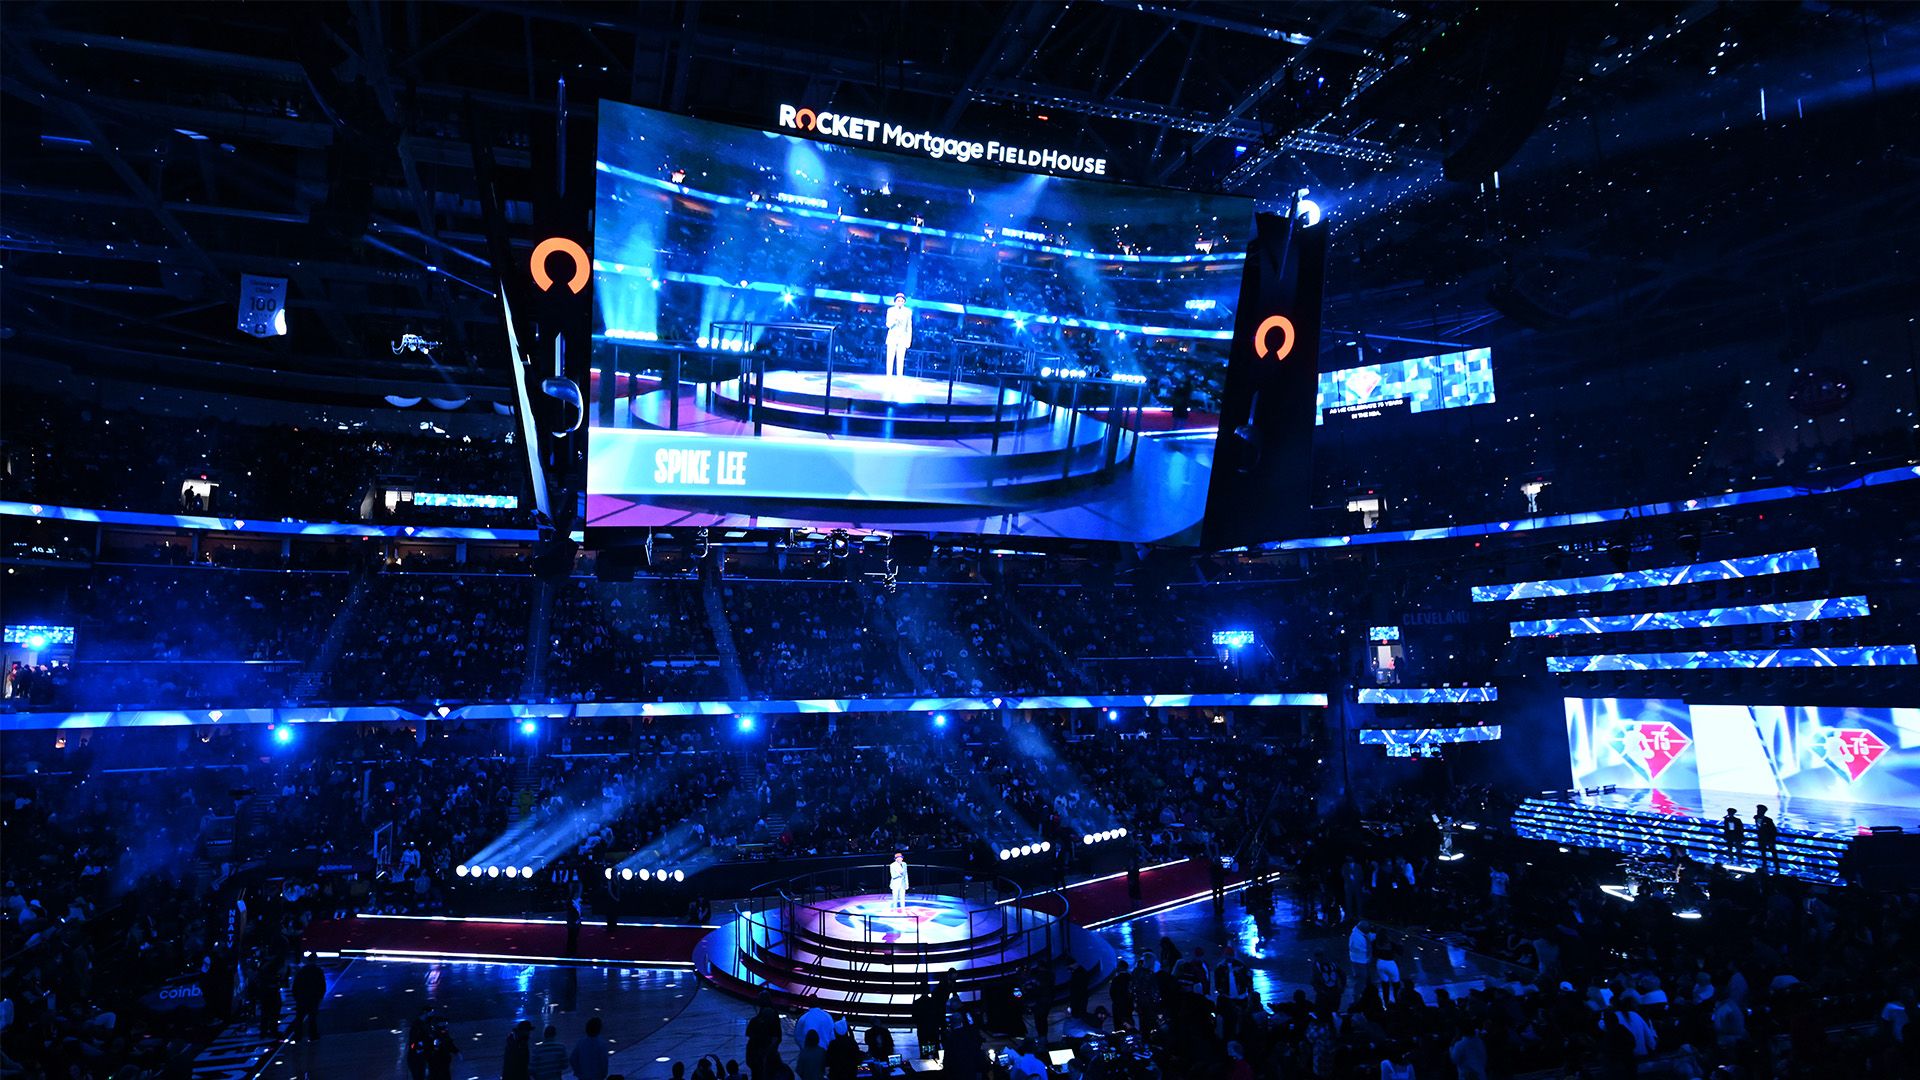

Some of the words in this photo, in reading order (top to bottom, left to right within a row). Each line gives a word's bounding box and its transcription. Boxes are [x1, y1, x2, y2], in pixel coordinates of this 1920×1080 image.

[779, 104, 880, 142] ROCKET
[882, 123, 984, 163] Mortgage
[986, 140, 1107, 175] FIELDHOUSE
[654, 448, 711, 484] SPIKE
[717, 450, 748, 485] LEE
[1650, 730, 1670, 751] 75
[1850, 737, 1870, 755] 75
[160, 983, 204, 999] coinb
